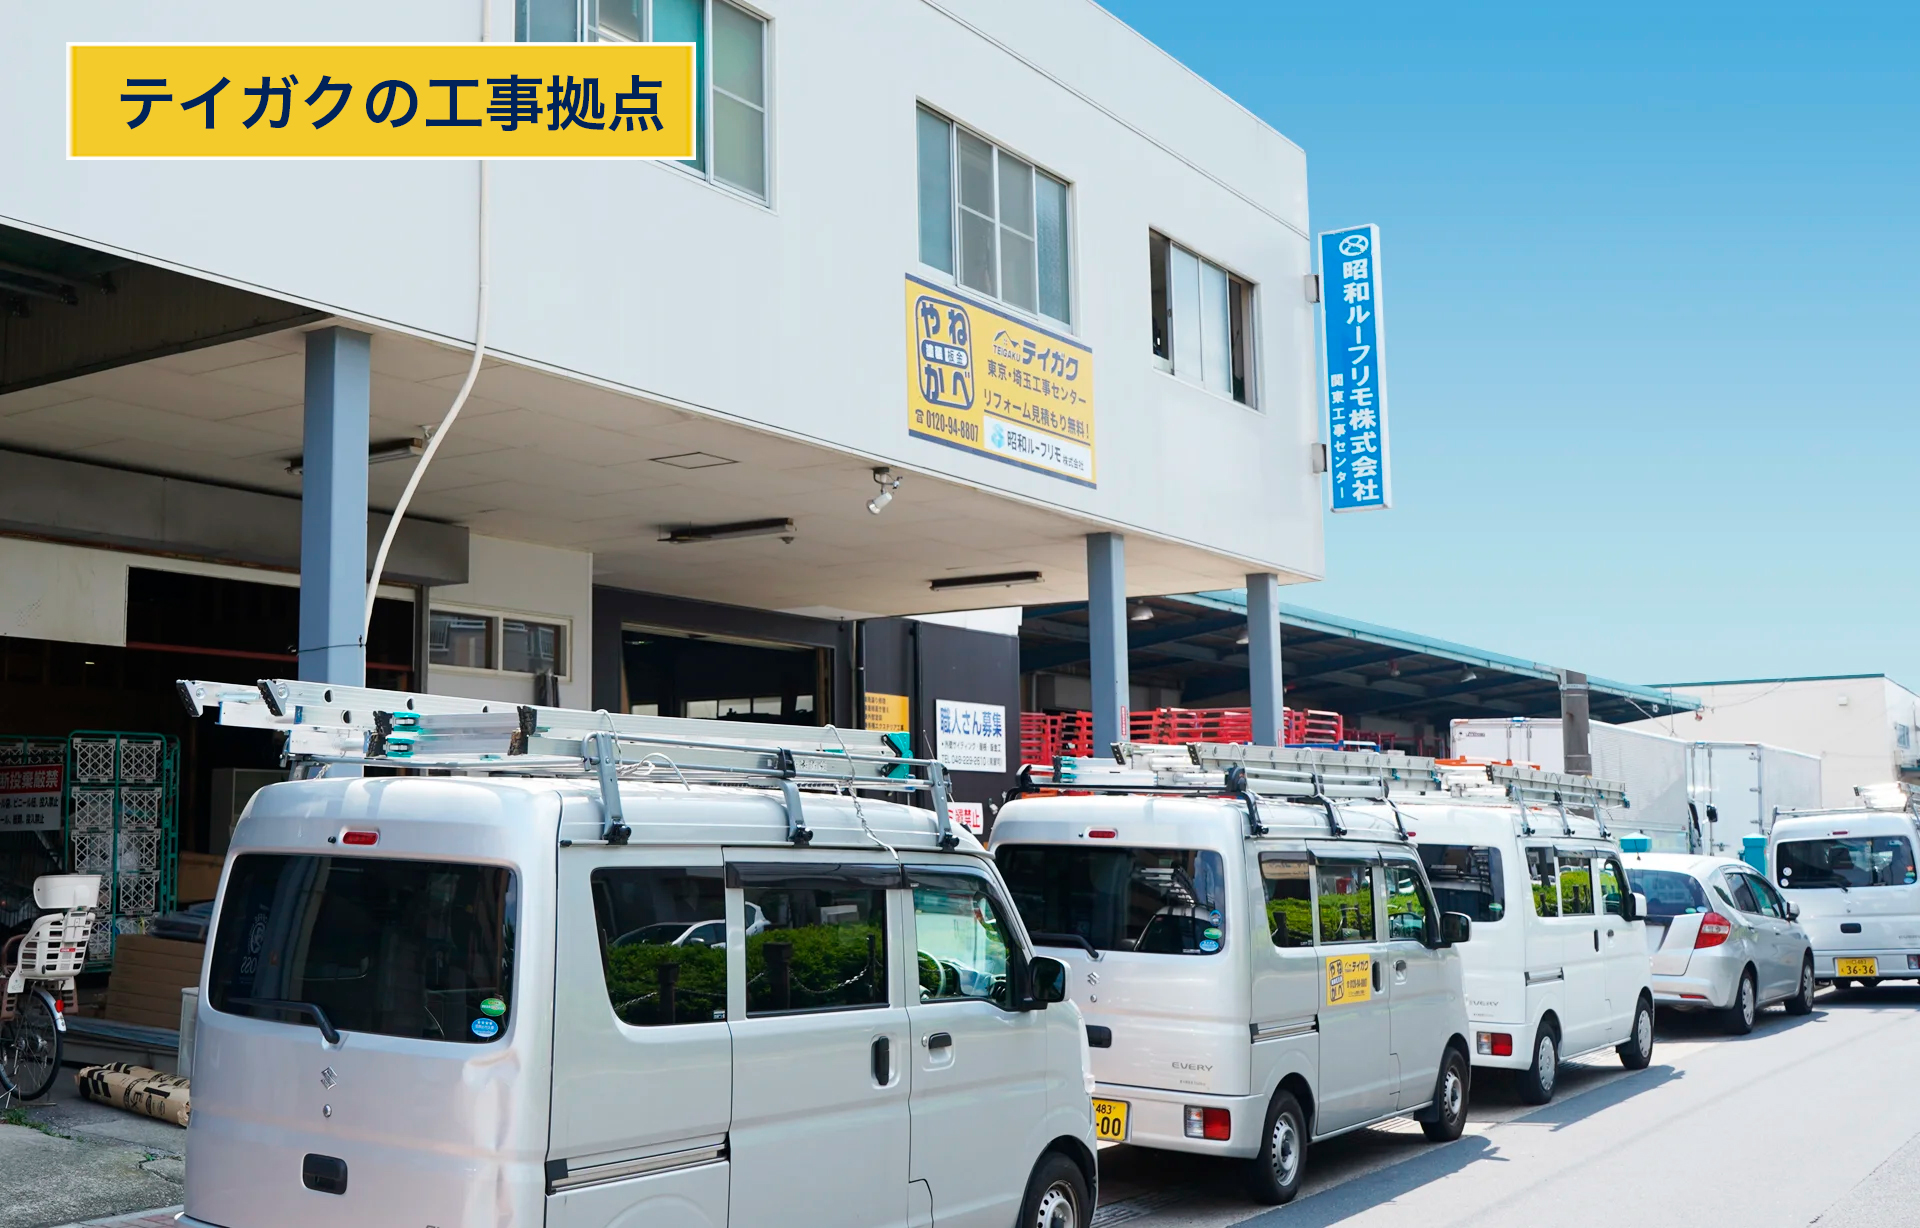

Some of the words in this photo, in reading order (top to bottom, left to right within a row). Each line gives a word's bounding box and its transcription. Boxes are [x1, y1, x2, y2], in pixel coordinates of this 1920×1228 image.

[921, 301, 968, 346] やね
[993, 344, 1021, 362] TEIGAKU
[1022, 339, 1079, 381] テイガク
[925, 364, 971, 406] かべ
[987, 359, 1087, 405] 東京・埼玉工事センター
[1343, 258, 1380, 502] 昭和ルーフリモ株式会社
[926, 409, 979, 443] 0120-94-8807
[1330, 373, 1347, 499] 関東工事センター
[1007, 430, 1062, 464] 昭和ルーフリモ
[940, 707, 1002, 738] 職人さん募集
[1846, 965, 1874, 975] 36-36
[1171, 1061, 1213, 1071] EVERY
